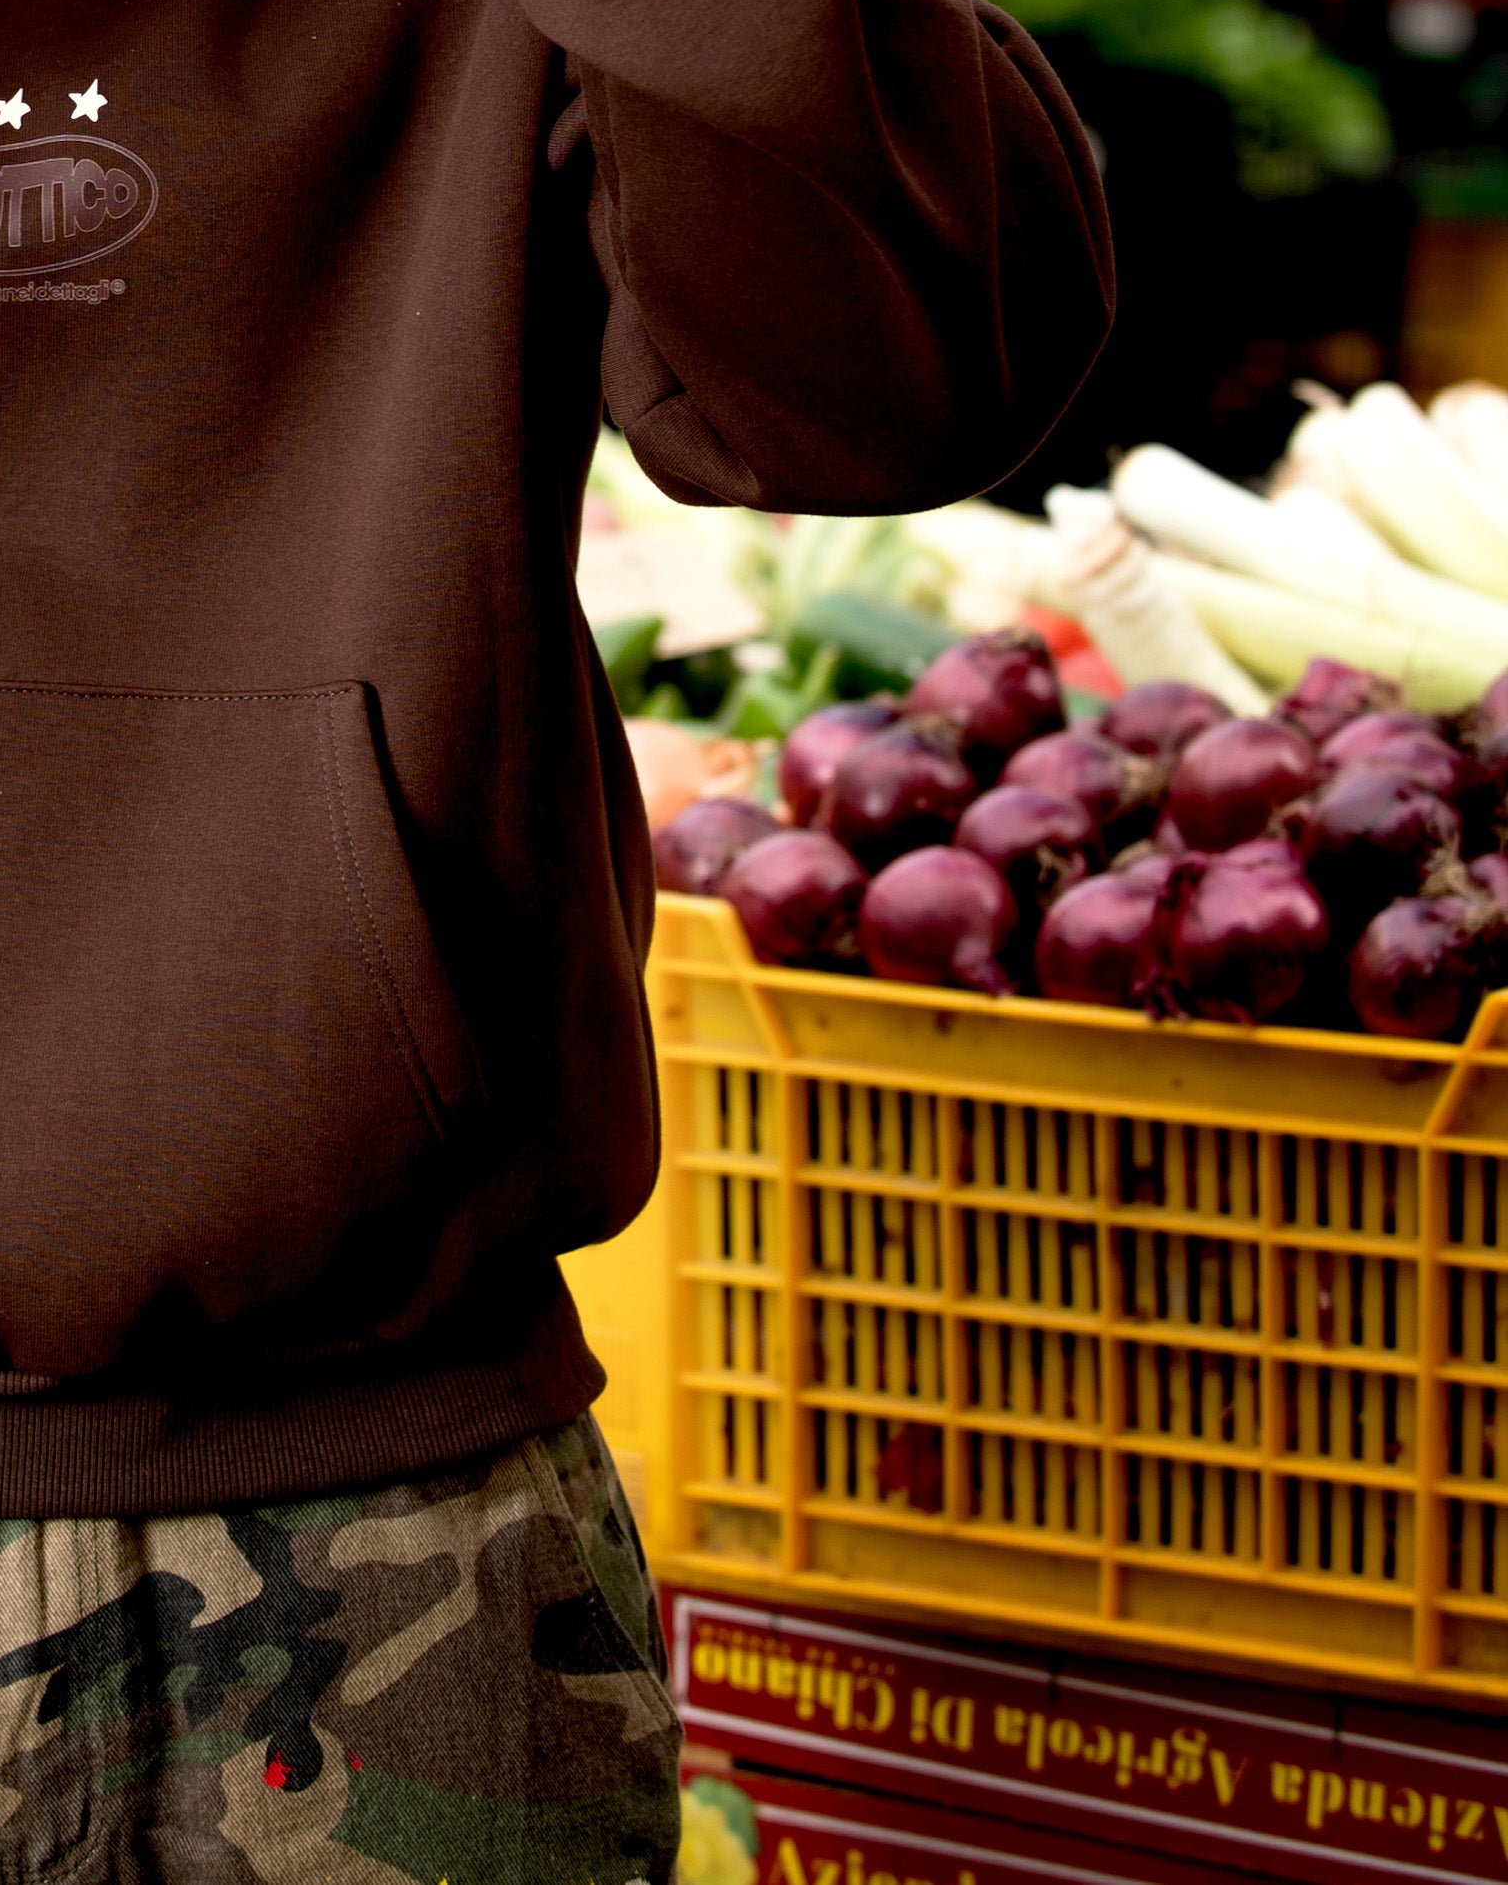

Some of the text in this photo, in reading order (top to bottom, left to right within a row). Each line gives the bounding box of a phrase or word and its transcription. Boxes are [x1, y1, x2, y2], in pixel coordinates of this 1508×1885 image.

[692, 1641, 895, 1733] Chiano
[909, 1687, 974, 1751] Di
[994, 1705, 1249, 1806] Agricola
